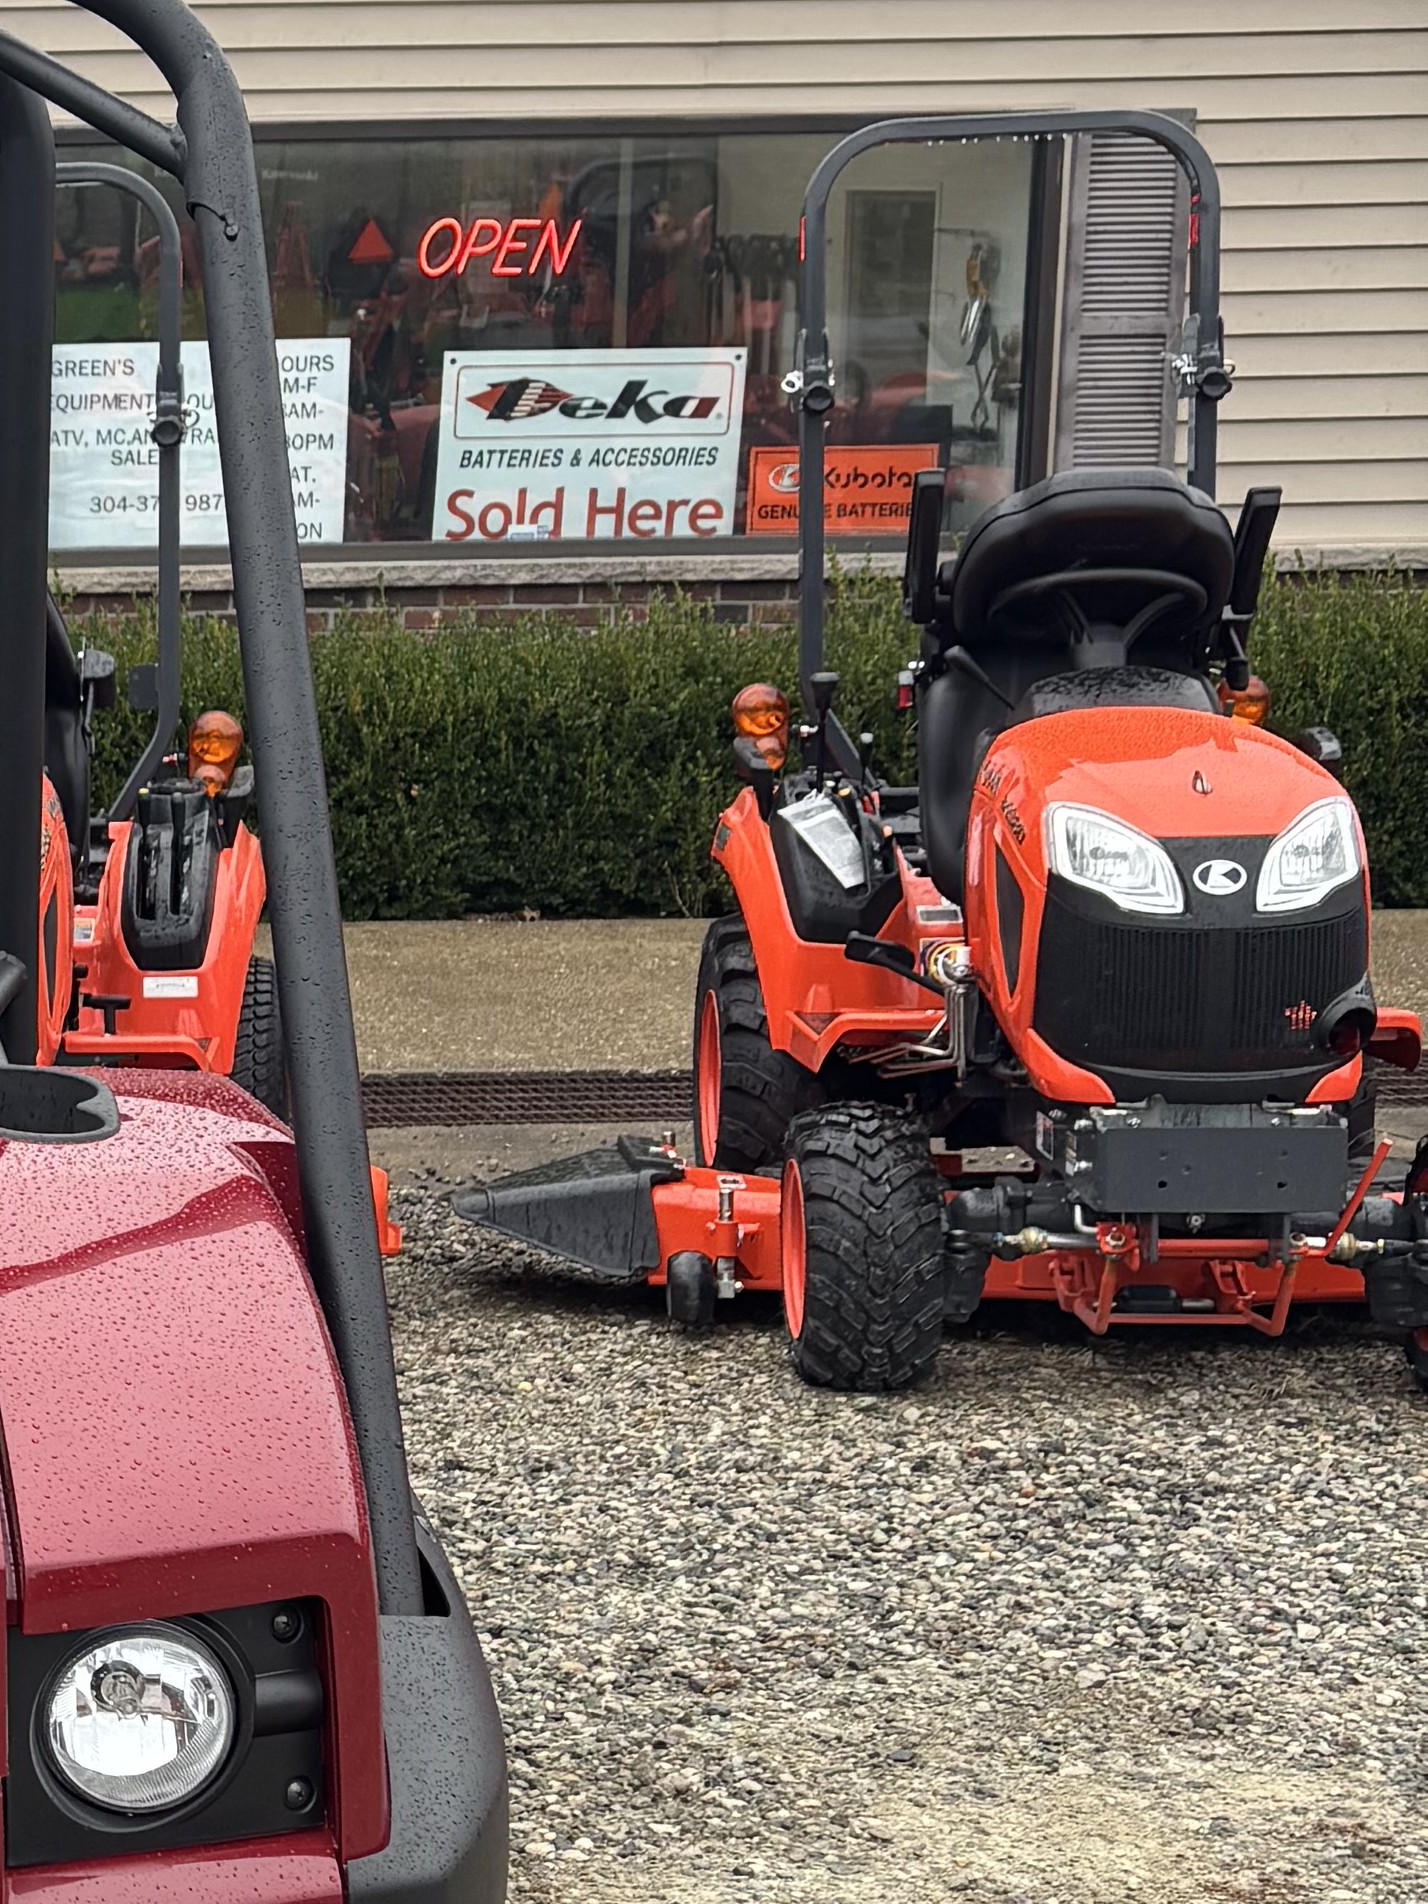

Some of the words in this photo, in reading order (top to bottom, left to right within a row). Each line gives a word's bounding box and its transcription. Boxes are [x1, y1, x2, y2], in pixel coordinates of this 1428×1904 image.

[416, 217, 582, 278] OPEN
[52, 358, 135, 378] GREEN'S
[281, 355, 335, 373] OURS
[283, 376, 319, 394] M-F
[51, 393, 157, 414] QUIPMENT
[466, 377, 721, 424] Deka
[459, 449, 564, 470] BATTERIES
[570, 449, 582, 467] &
[588, 447, 719, 468] ACCESSORIES
[291, 466, 317, 484] AT.
[444, 486, 565, 541] Sold
[586, 486, 724, 538] Here
[837, 501, 914, 518] BATTERIE
